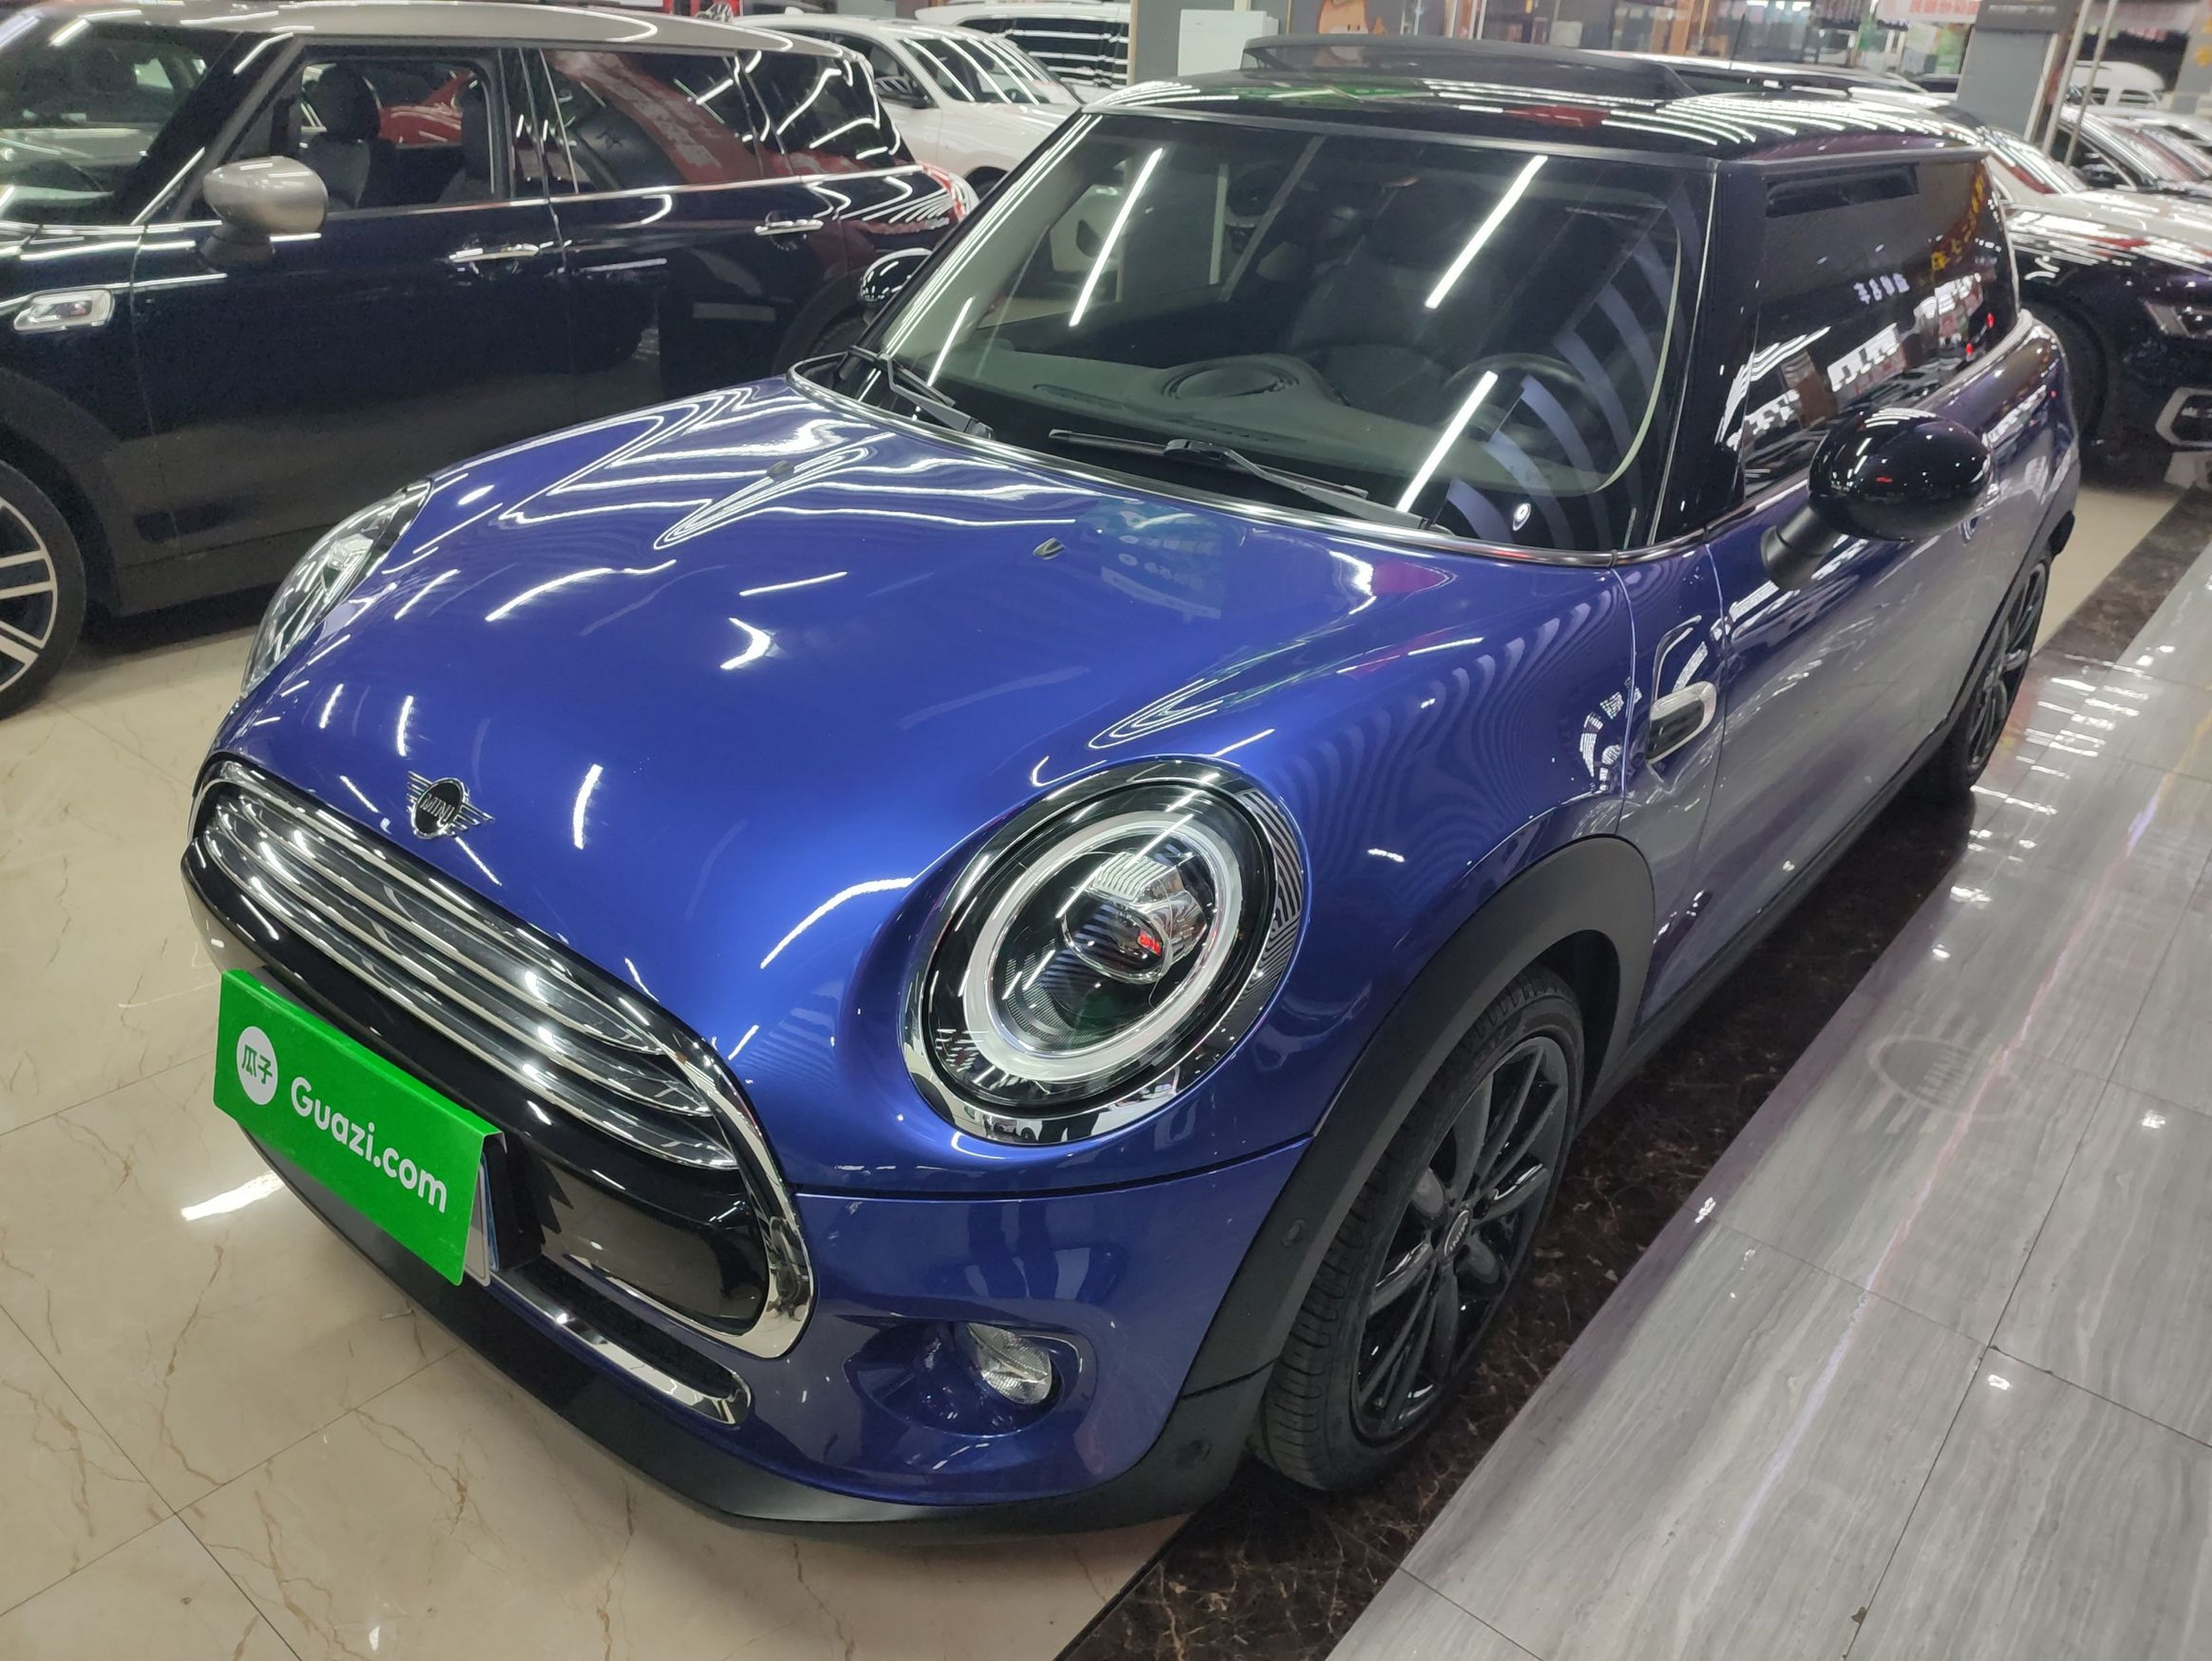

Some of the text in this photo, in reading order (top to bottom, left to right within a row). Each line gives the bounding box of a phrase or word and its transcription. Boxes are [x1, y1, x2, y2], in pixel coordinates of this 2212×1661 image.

[420, 793, 455, 822] MINI
[241, 1044, 274, 1085] 瓜子
[290, 1076, 447, 1213] Guazi.com
